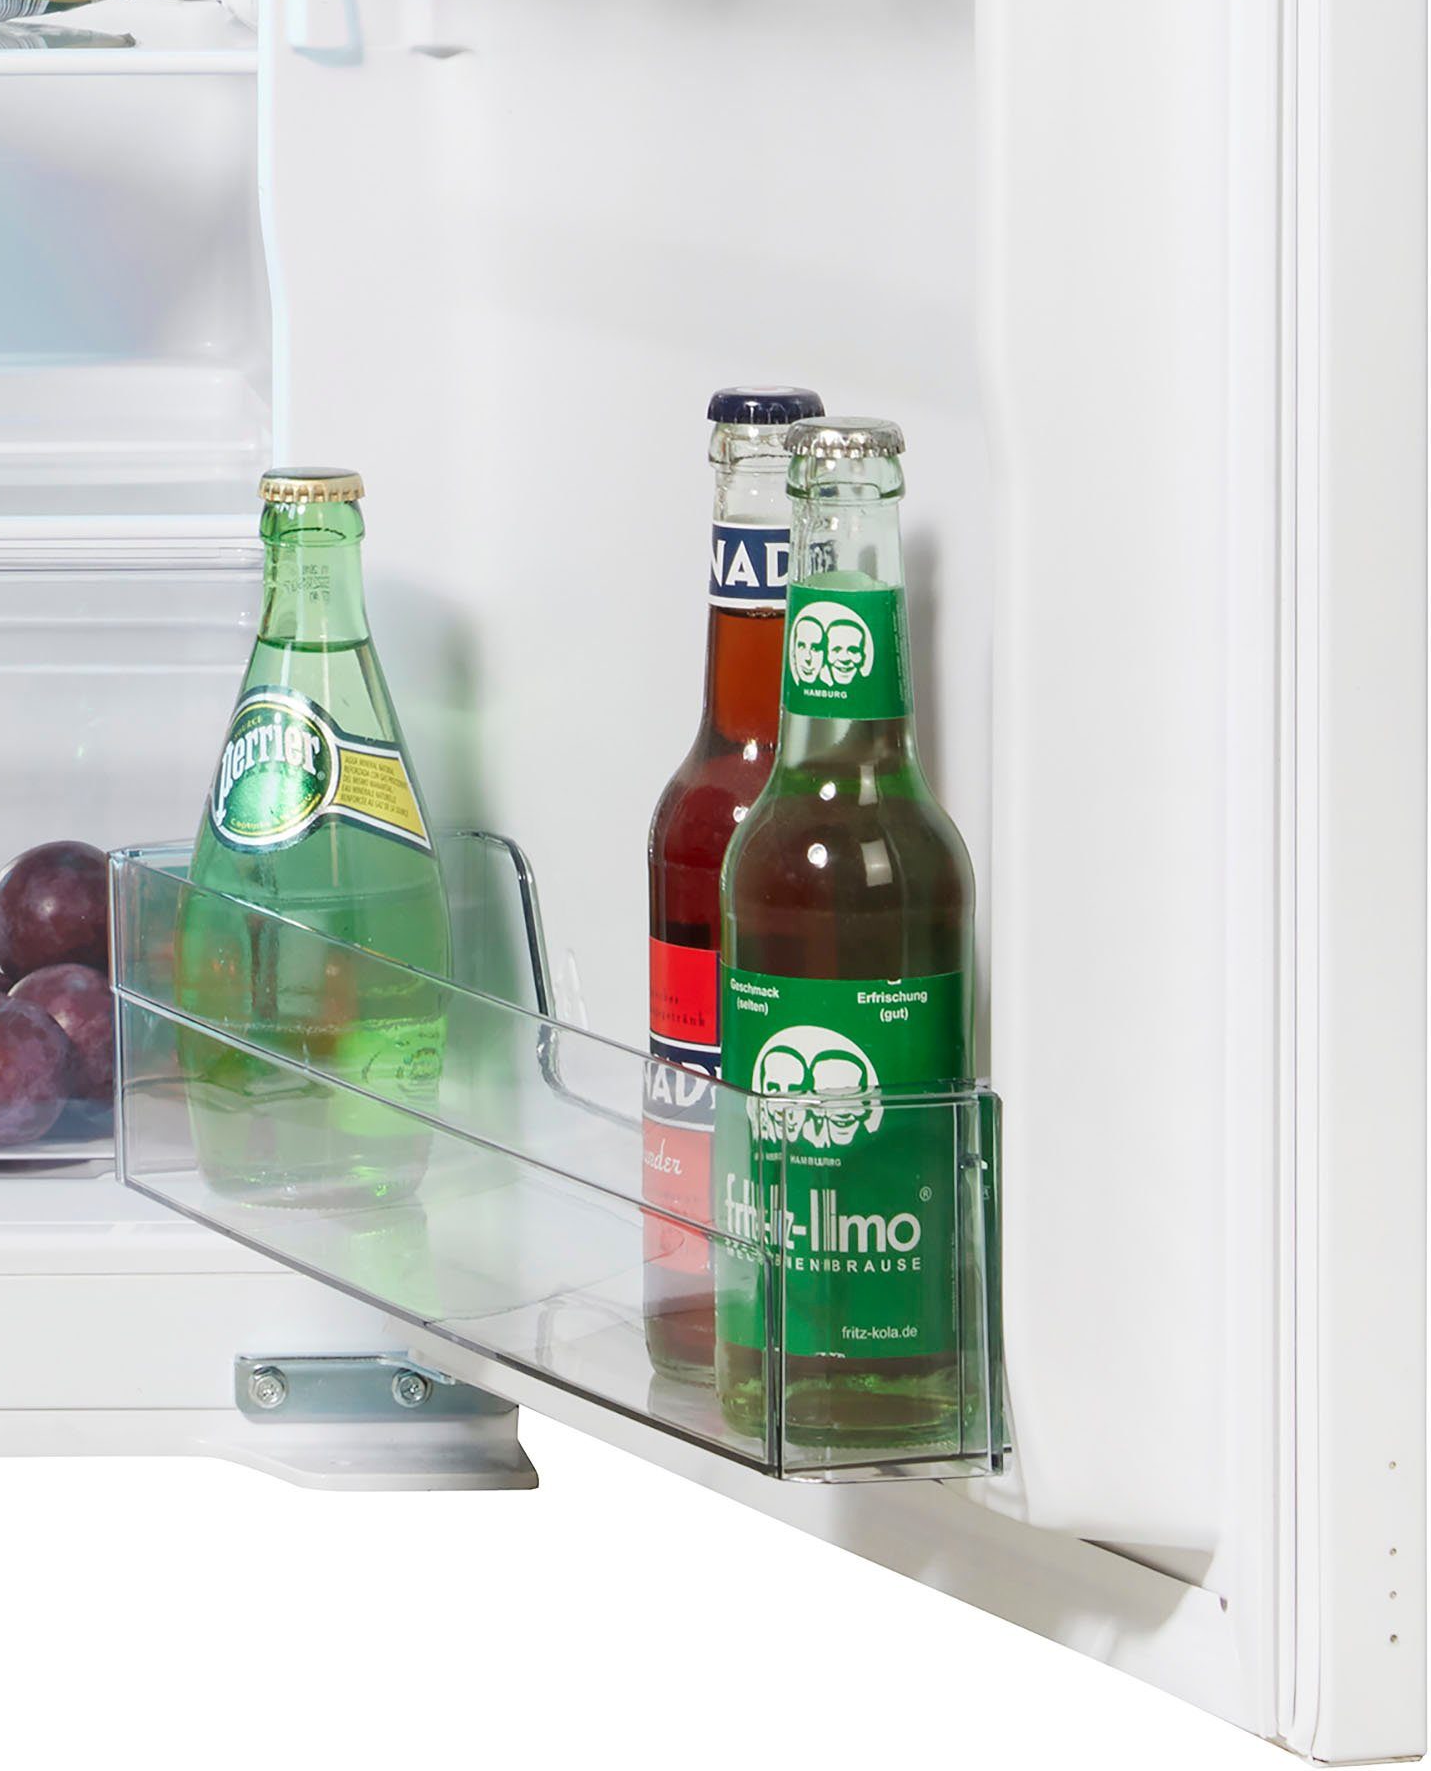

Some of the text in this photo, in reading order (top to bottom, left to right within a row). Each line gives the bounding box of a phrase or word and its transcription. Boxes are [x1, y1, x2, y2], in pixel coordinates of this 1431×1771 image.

[803, 688, 848, 699] HAMBURG
[730, 978, 780, 999] Geschmack
[857, 989, 928, 1005] Erfrischung
[736, 996, 768, 1016] (selten)
[880, 1005, 909, 1023] (gut)
[841, 1325, 918, 1340] fritz-kola.de
